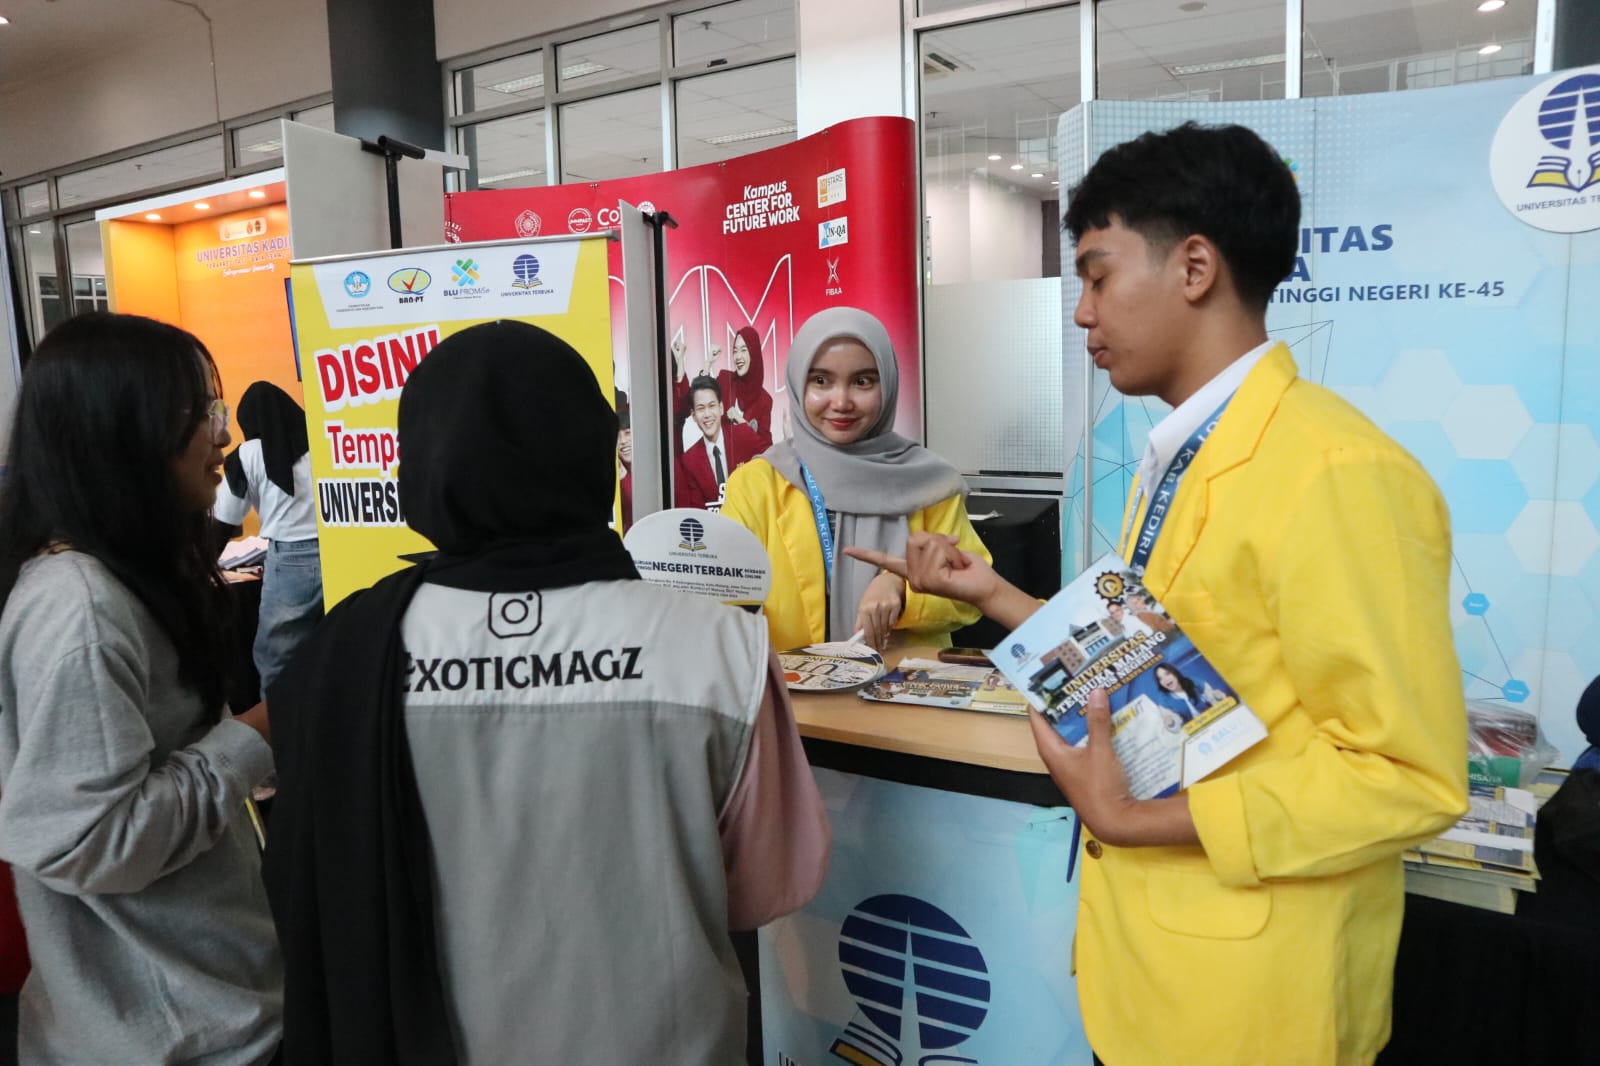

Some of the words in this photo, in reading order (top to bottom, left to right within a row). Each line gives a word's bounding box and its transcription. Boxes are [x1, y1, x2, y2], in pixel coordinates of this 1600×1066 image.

[743, 181, 787, 201] Kampus
[726, 197, 769, 219] CENTER
[771, 193, 793, 211] FOR
[1516, 196, 1586, 212] UNIVERSITAS
[596, 207, 621, 227] Co
[723, 213, 767, 235] FUTURE
[767, 206, 801, 227] WORK
[196, 241, 259, 263] UNIVERSITAS
[443, 289, 458, 297] BLU
[532, 288, 555, 296] TERBUKA
[825, 287, 843, 297] FIBAA
[1348, 283, 1430, 302] NEGERI
[1438, 281, 1505, 299] KE-45
[652, 561, 693, 575] NEGERI
[694, 564, 744, 579] TERBAIK
[1056, 668, 1116, 714] TERBUKA
[1113, 631, 1167, 673] MALANG
[1062, 630, 1147, 695] UNIVERSITAS
[1117, 650, 1156, 679] NEGERI
